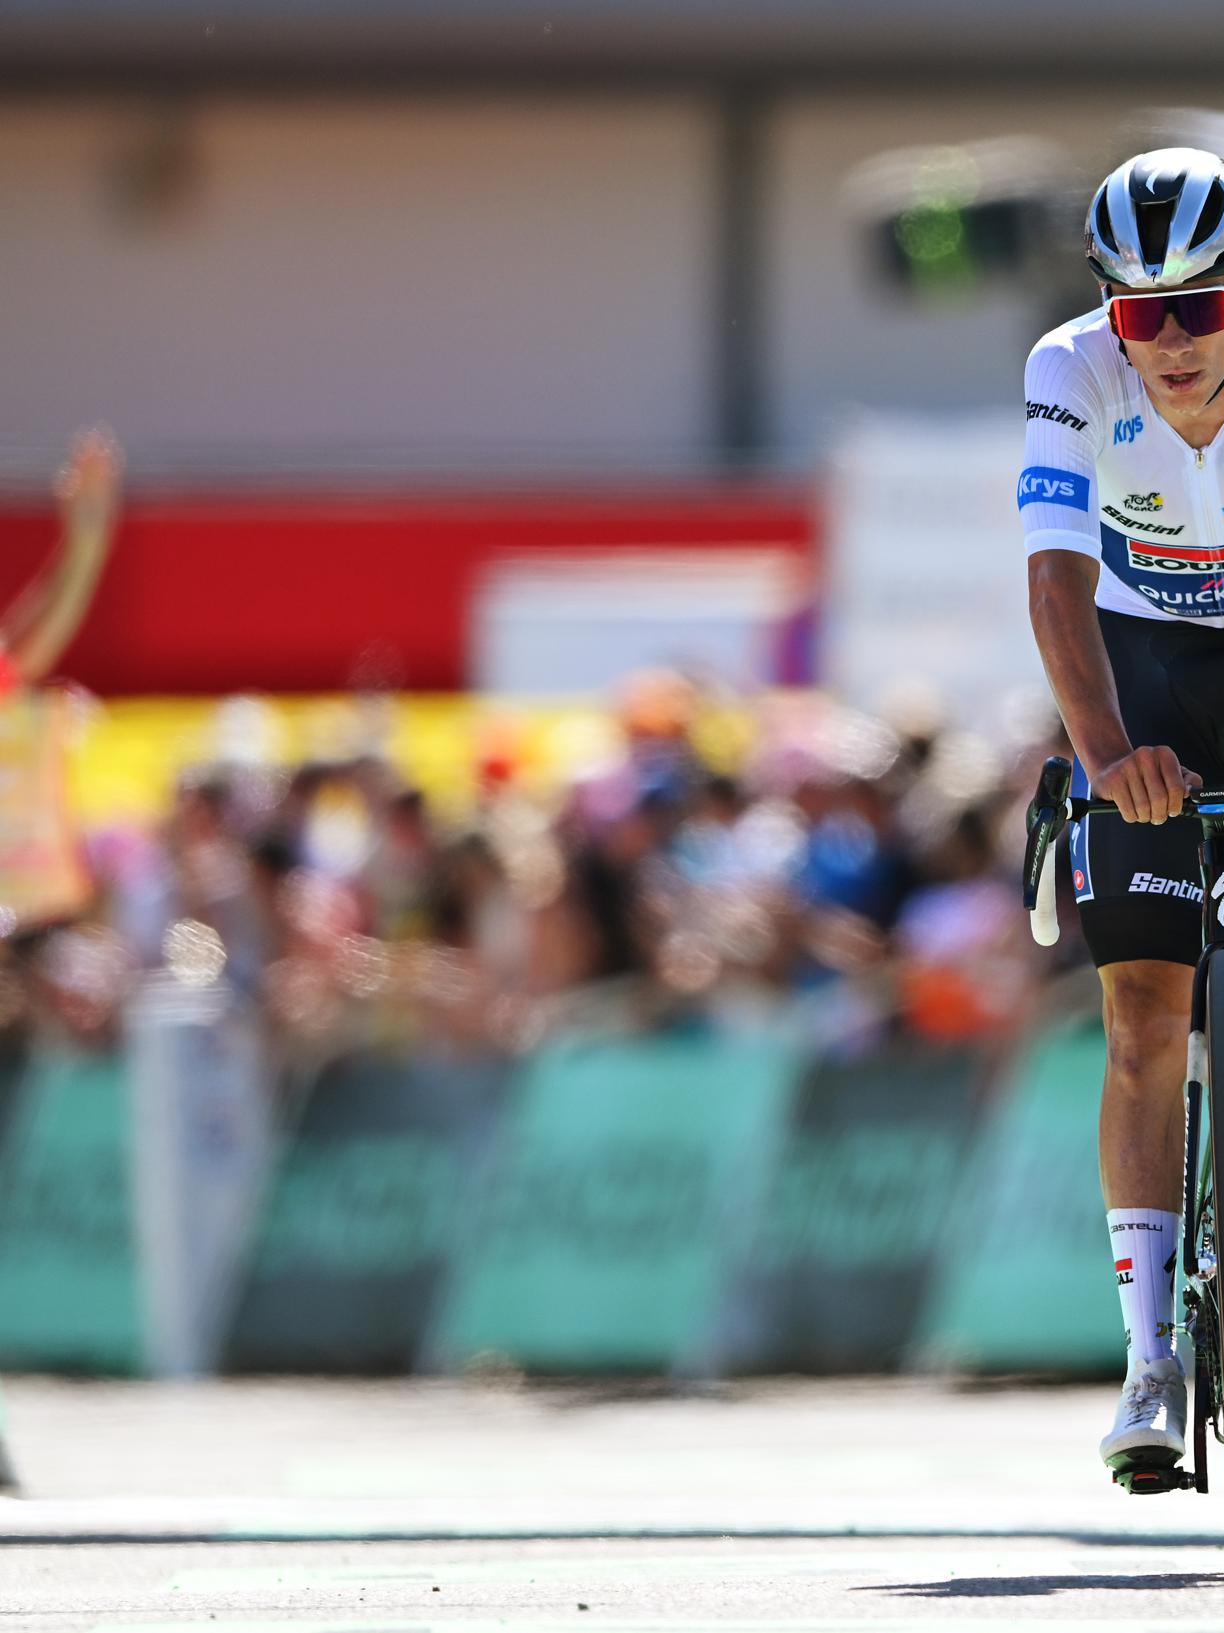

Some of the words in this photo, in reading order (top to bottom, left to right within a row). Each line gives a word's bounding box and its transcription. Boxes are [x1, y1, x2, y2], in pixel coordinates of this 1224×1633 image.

[1113, 415, 1144, 446] Krys
[1018, 474, 1075, 498] Krys
[1102, 505, 1185, 535] Santini
[1128, 872, 1204, 905] Santin
